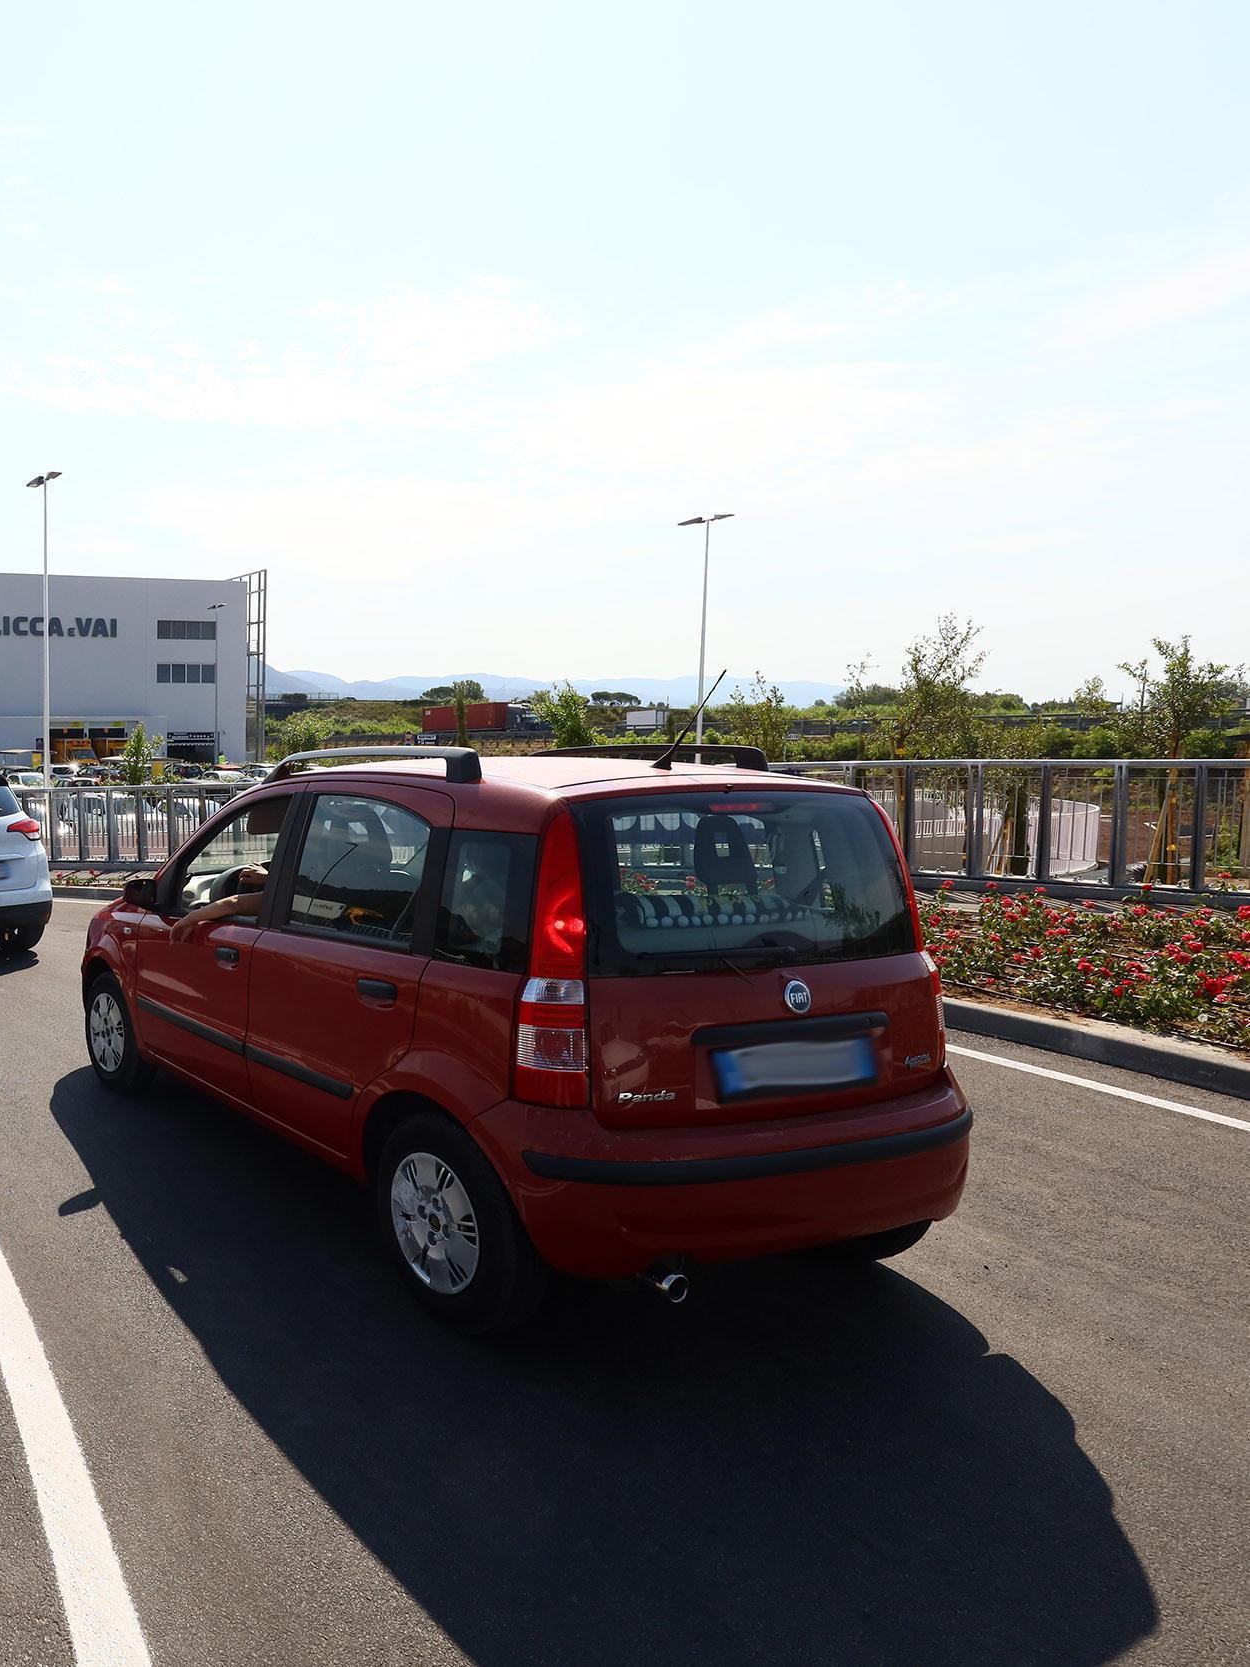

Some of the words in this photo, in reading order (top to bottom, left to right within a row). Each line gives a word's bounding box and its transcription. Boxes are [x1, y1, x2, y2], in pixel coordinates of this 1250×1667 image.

[76, 617, 118, 638] VAI
[790, 992, 808, 1004] FIAT
[617, 1090, 676, 1104] Panda
